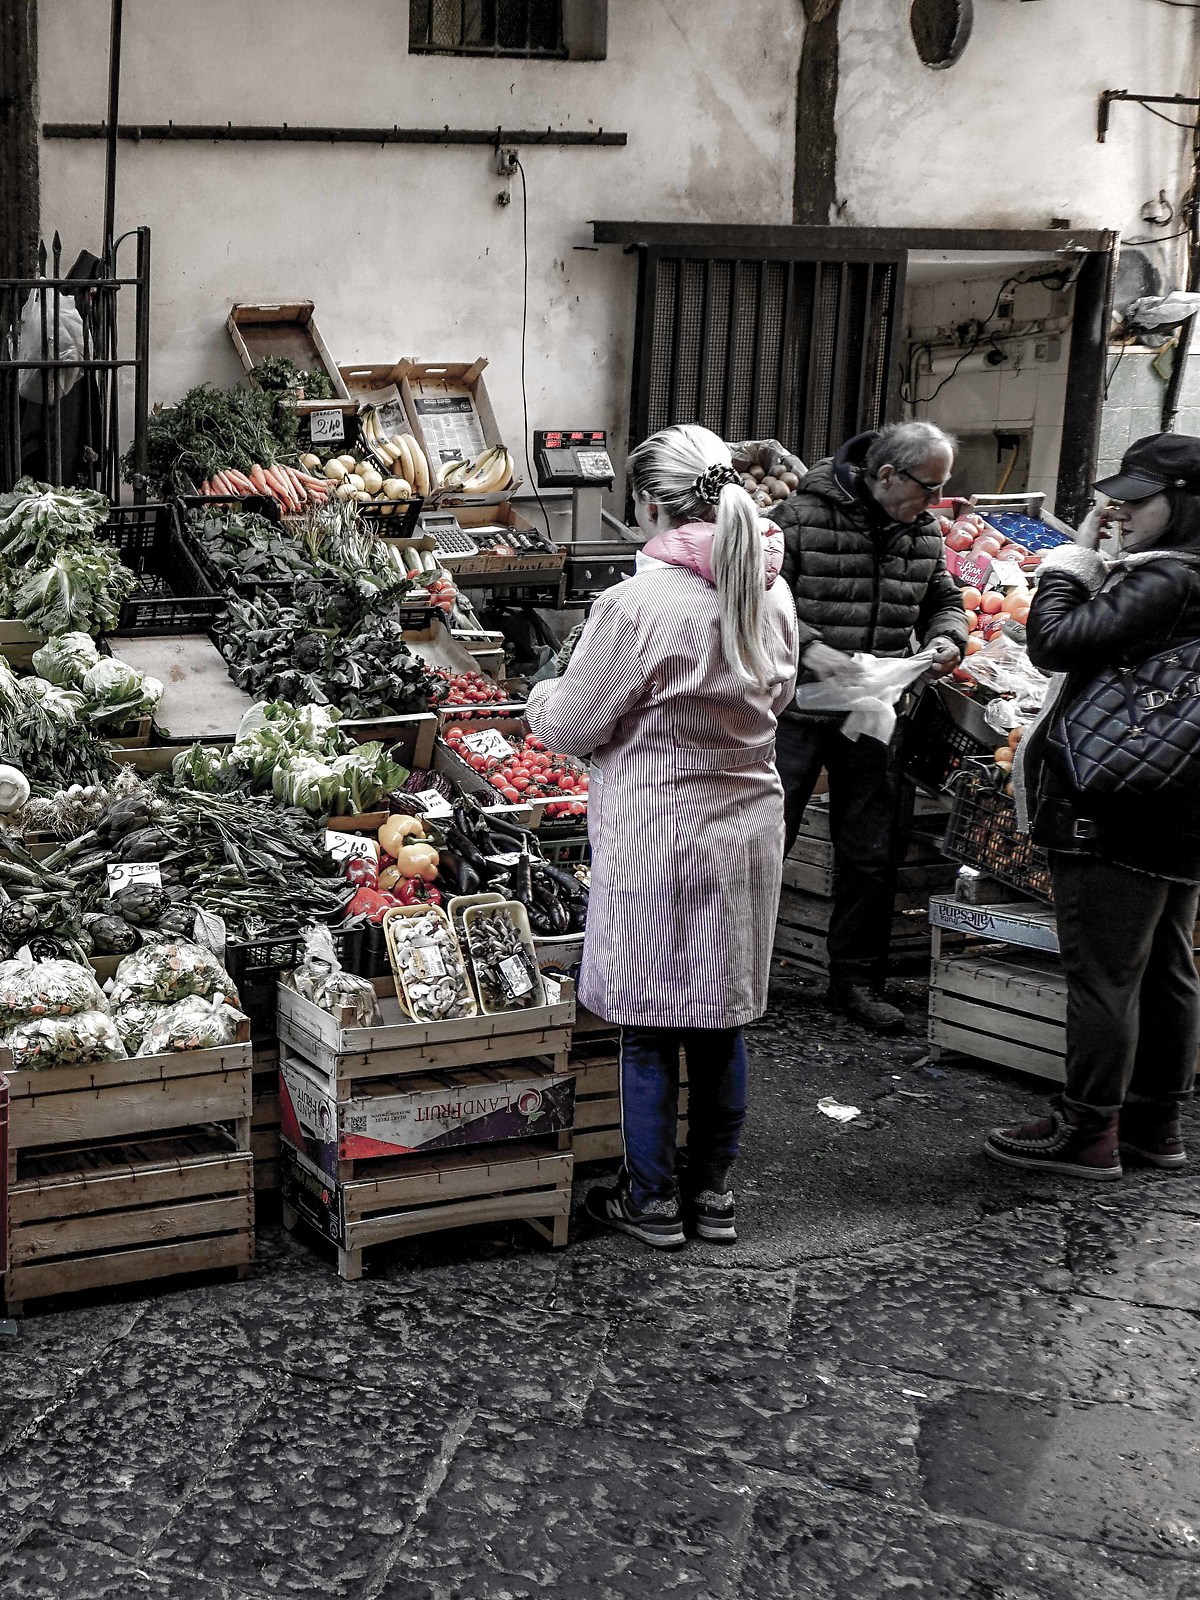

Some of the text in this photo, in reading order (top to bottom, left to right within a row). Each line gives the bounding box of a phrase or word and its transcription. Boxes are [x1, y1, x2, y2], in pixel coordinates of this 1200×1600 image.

[957, 560, 982, 574] Pink
[959, 571, 981, 587] Lady
[107, 864, 125, 881] 5
[939, 904, 996, 931] Vallesana
